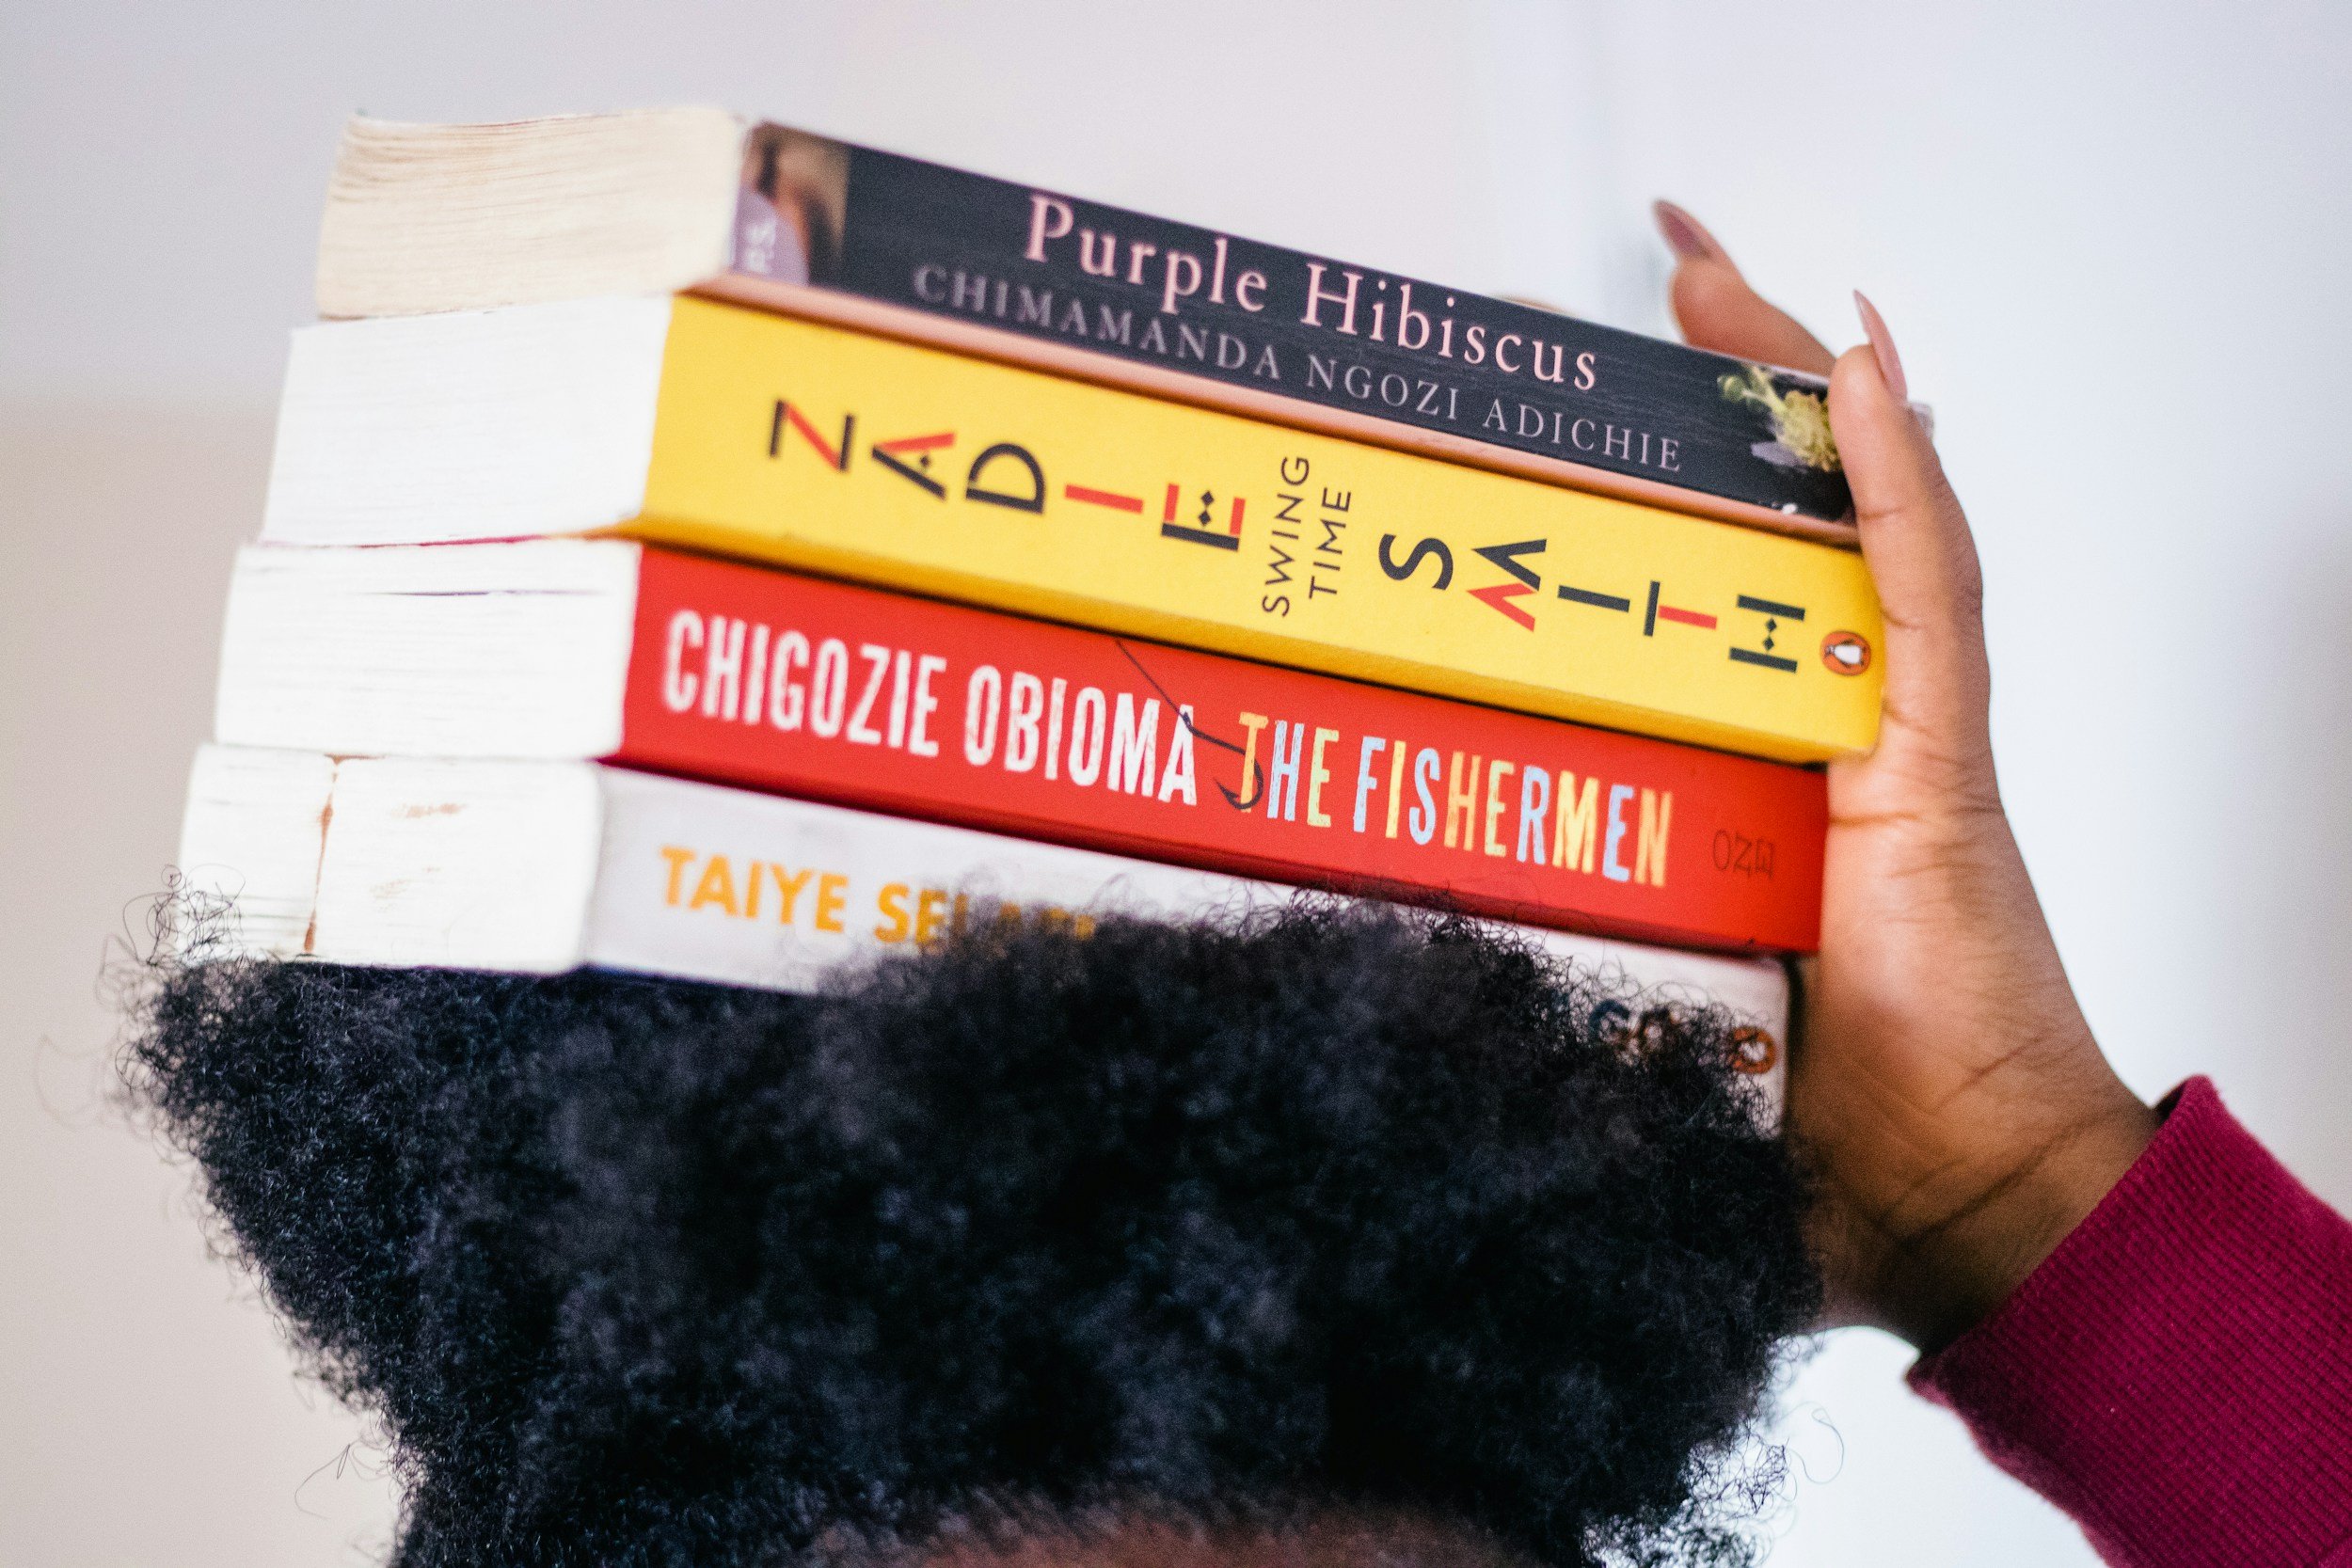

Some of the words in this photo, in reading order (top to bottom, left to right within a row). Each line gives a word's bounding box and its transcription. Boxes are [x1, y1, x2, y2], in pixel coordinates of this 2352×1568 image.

[913, 263, 1281, 382] CHIMAMANDA
[1306, 354, 1460, 420] NGOZI
[1482, 398, 1682, 473] ADICHIE
[1025, 195, 1267, 316] Purple
[1300, 261, 1597, 393] Hibiscus
[768, 397, 1247, 553] ZADIE
[1262, 456, 1310, 617] SWING
[1309, 486, 1352, 599] TIME
[1377, 532, 1806, 673] SMITH
[661, 608, 947, 757] CHIGOZIE
[961, 664, 1198, 807] OBIOMA
[1235, 711, 1340, 828] THE
[1353, 736, 1672, 888] FISHERMEN
[660, 846, 849, 933] TAIYE
